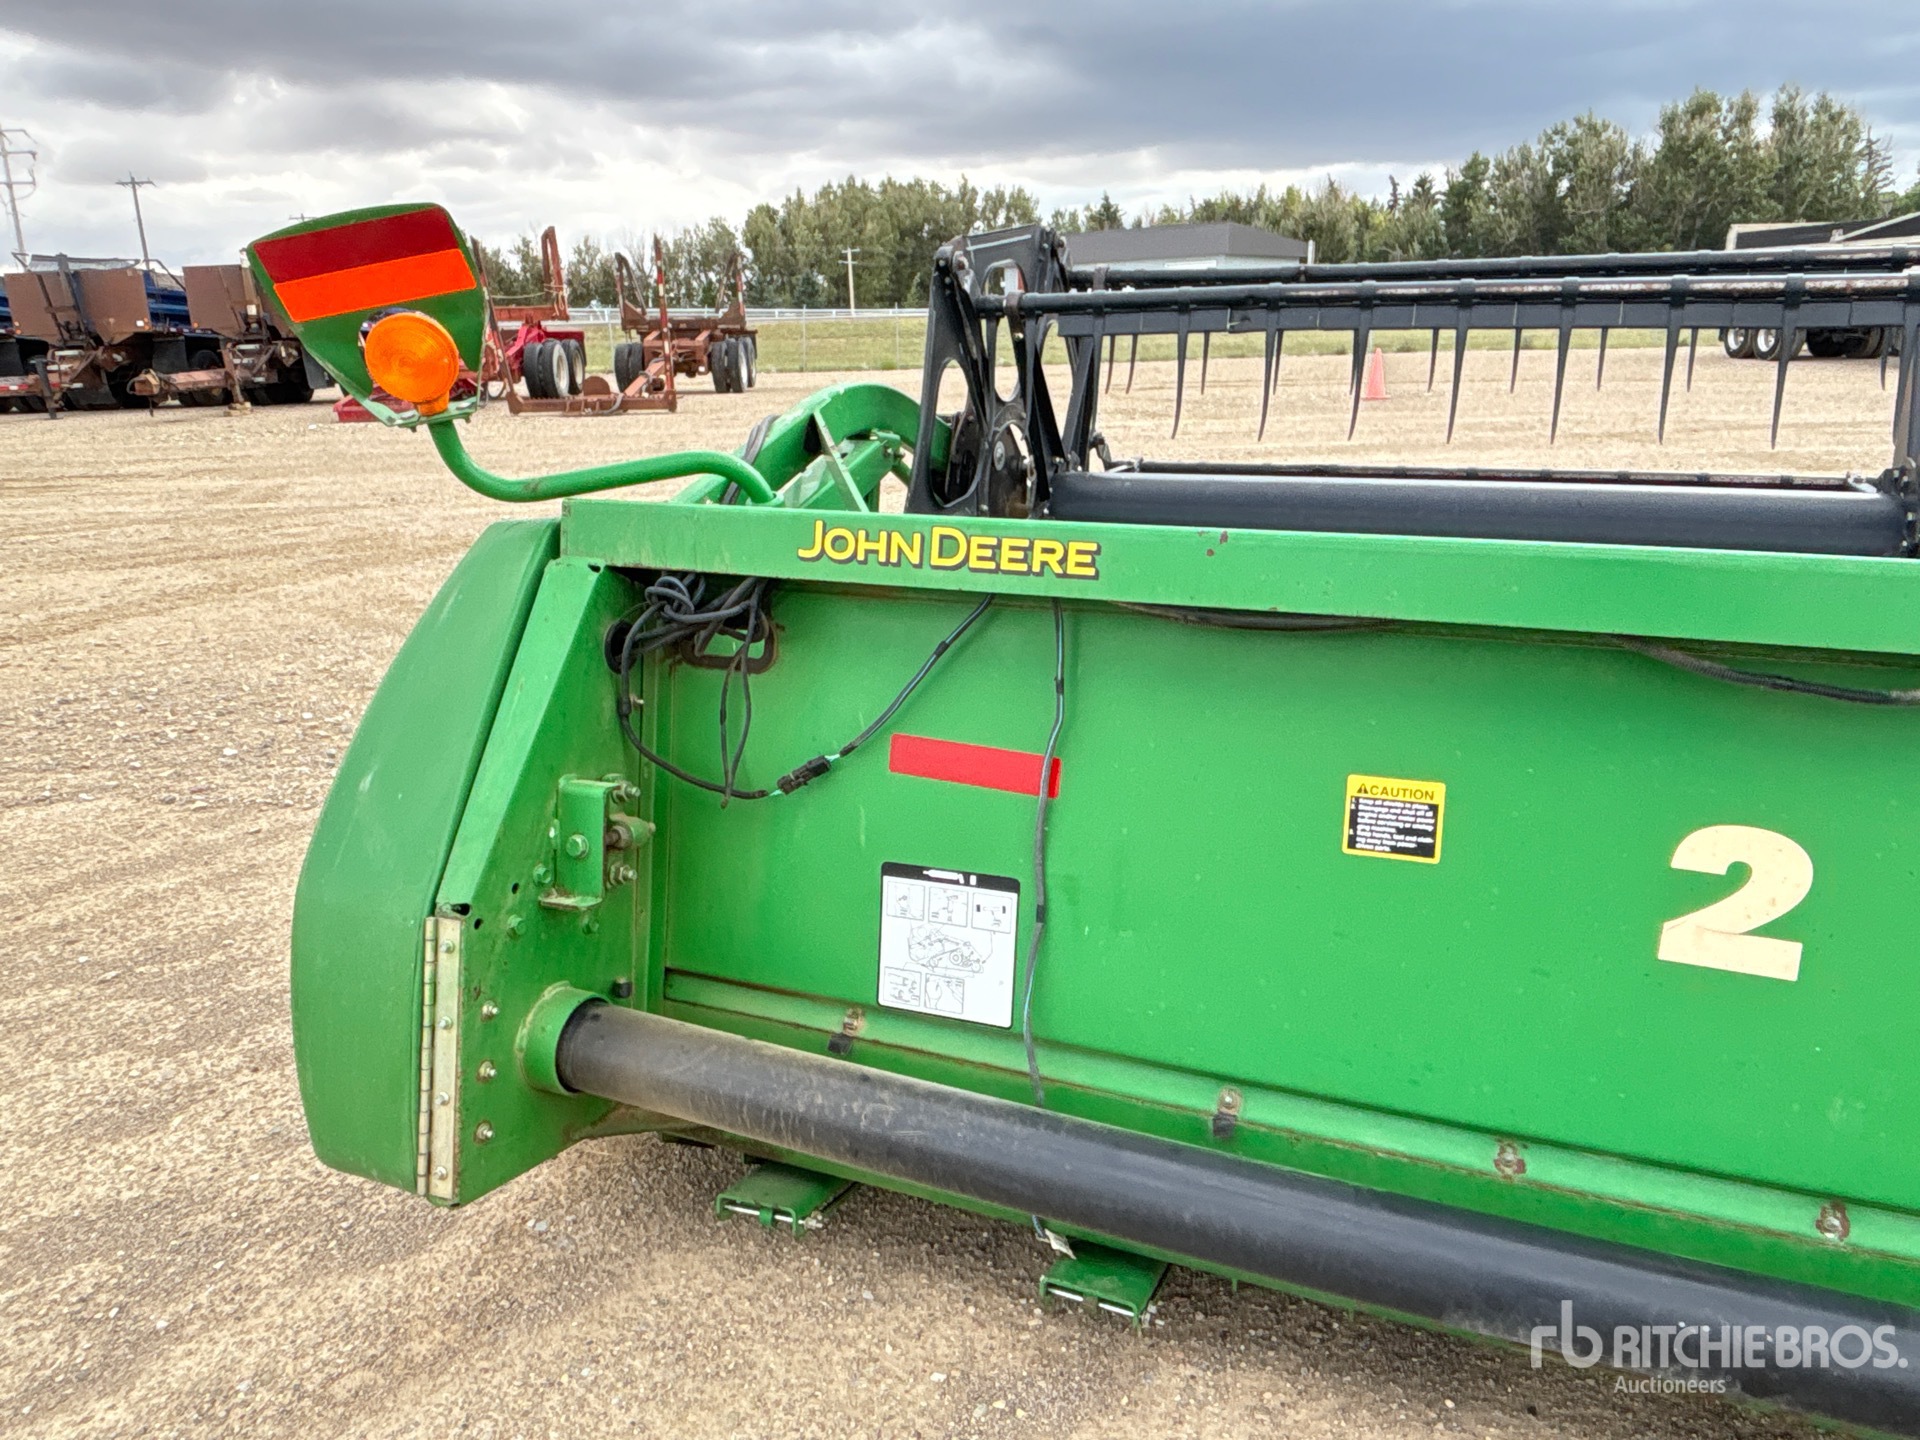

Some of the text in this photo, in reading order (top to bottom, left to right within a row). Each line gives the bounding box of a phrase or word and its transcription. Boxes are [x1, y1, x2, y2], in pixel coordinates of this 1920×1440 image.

[797, 520, 1102, 580] JOHN DEERE
[1370, 785, 1434, 800] CAUTION
[1657, 824, 1814, 982] 2
